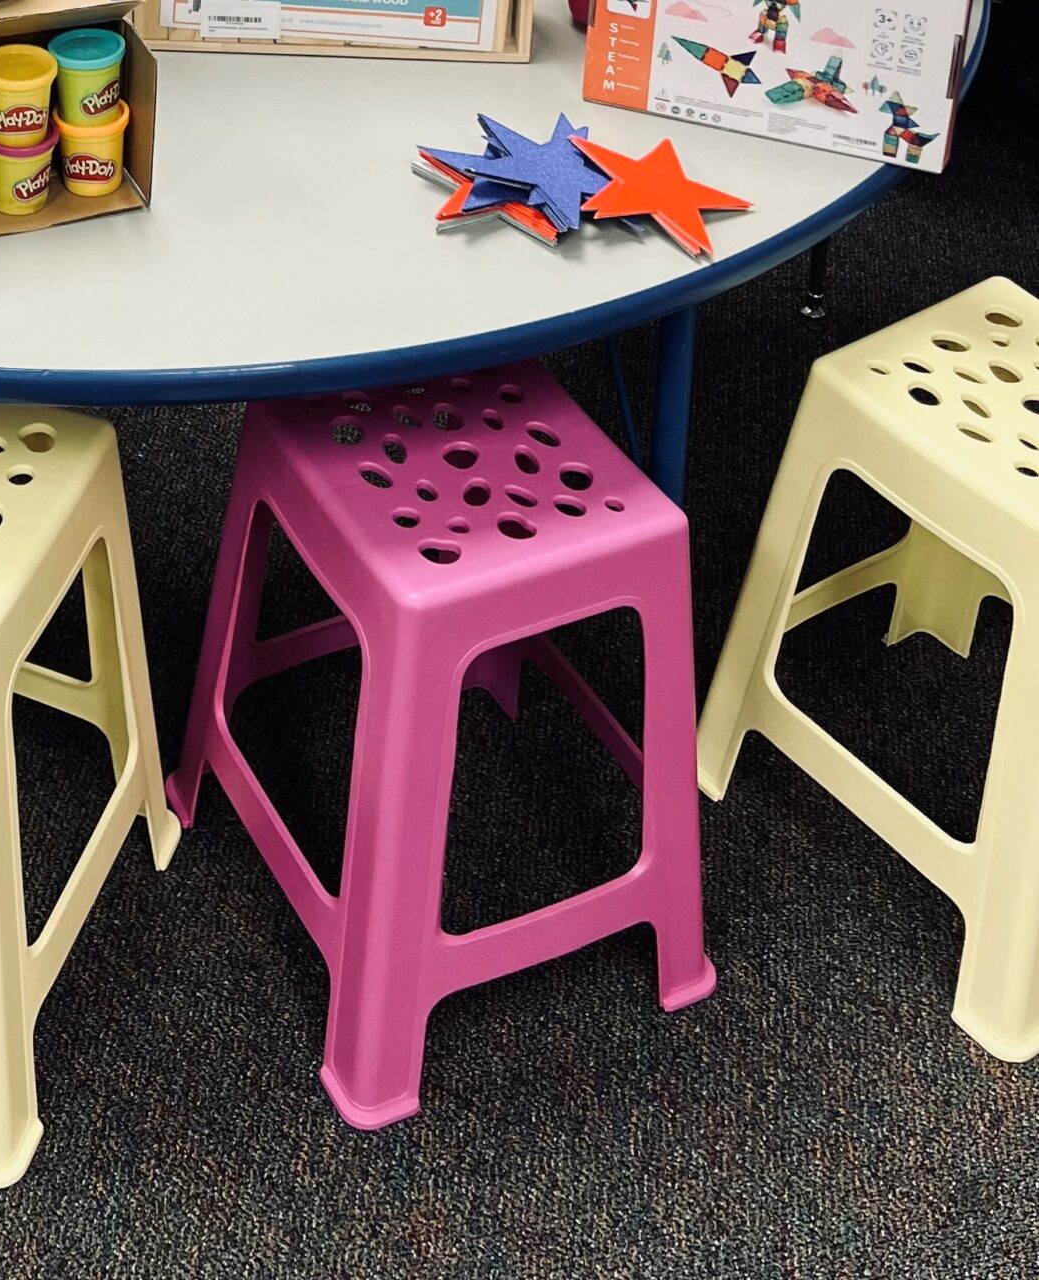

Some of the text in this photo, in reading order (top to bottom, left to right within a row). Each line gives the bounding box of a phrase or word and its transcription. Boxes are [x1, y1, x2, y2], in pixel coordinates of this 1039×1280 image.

[428, 8, 443, 21] +2
[878, 13, 893, 24] 3+
[82, 82, 120, 113] Play-D
